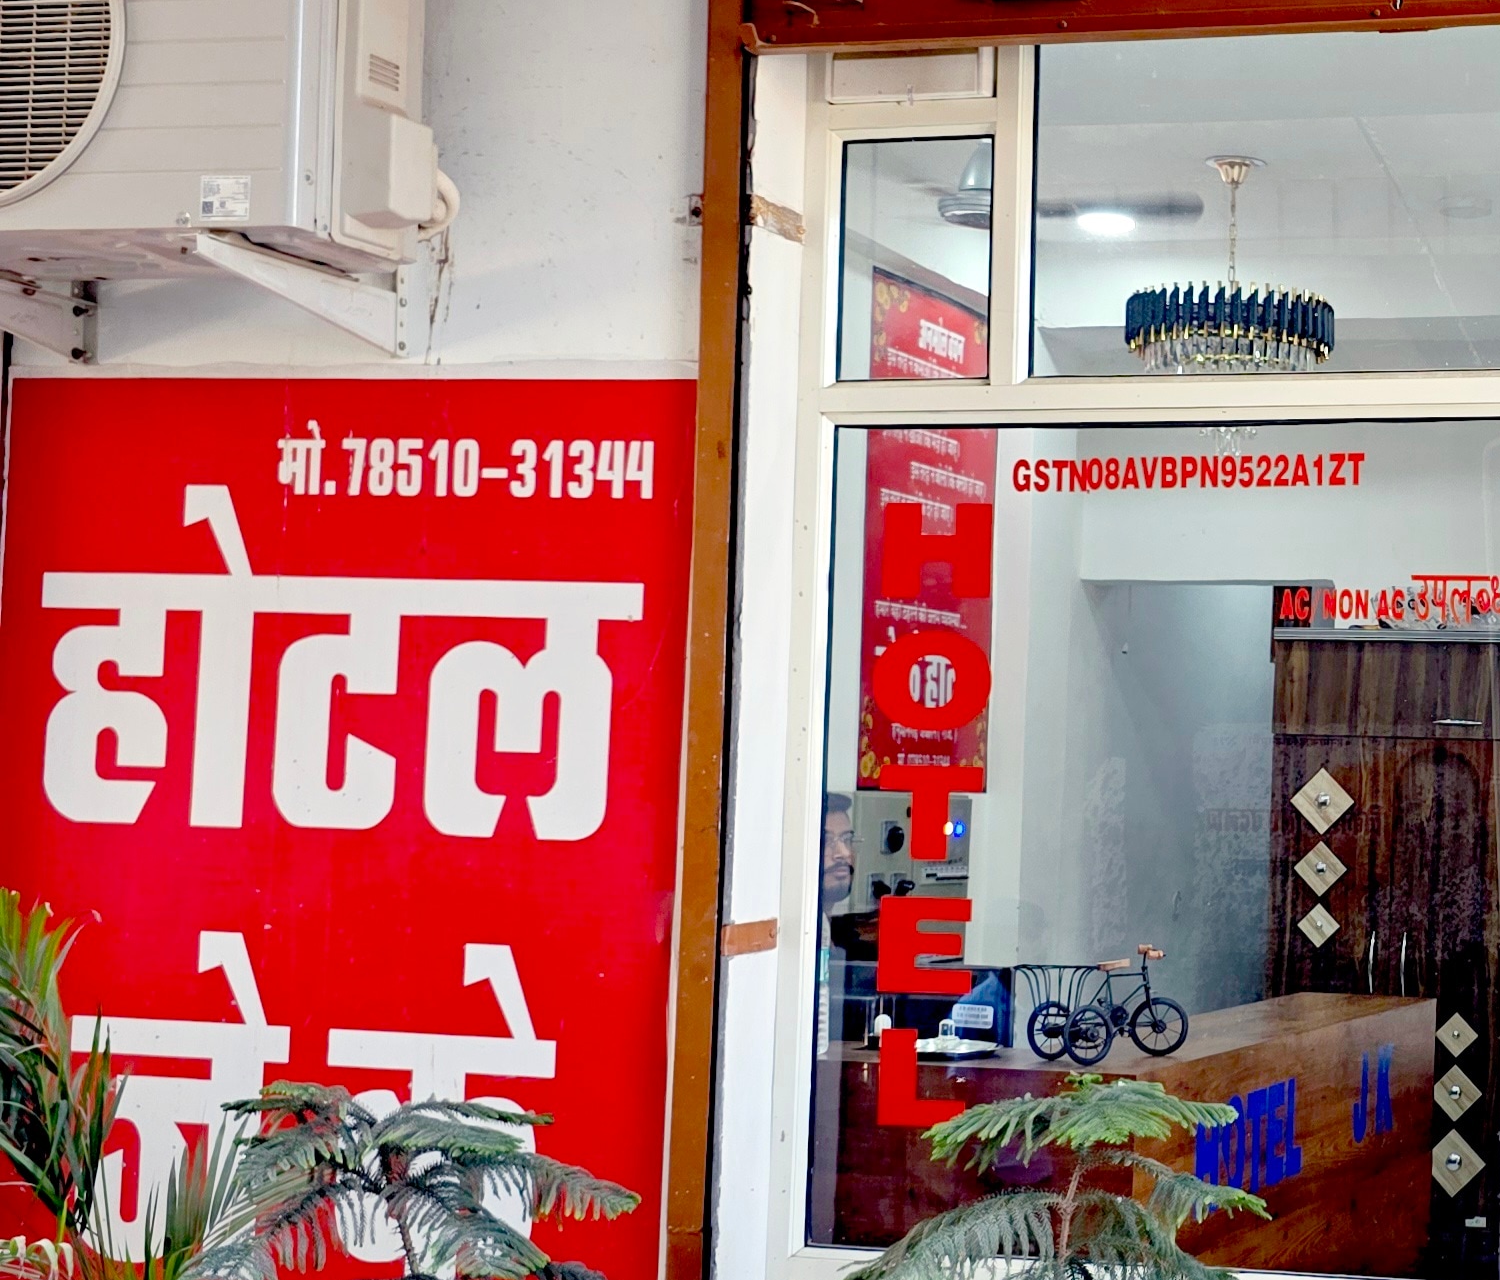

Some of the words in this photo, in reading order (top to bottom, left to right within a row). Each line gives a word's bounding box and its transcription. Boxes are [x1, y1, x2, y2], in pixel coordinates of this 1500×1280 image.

[42, 485, 643, 841] होटल
[1376, 589, 1405, 621] AC
[872, 504, 993, 1127] HOTEL
[1194, 1077, 1304, 1213] HOTEL
